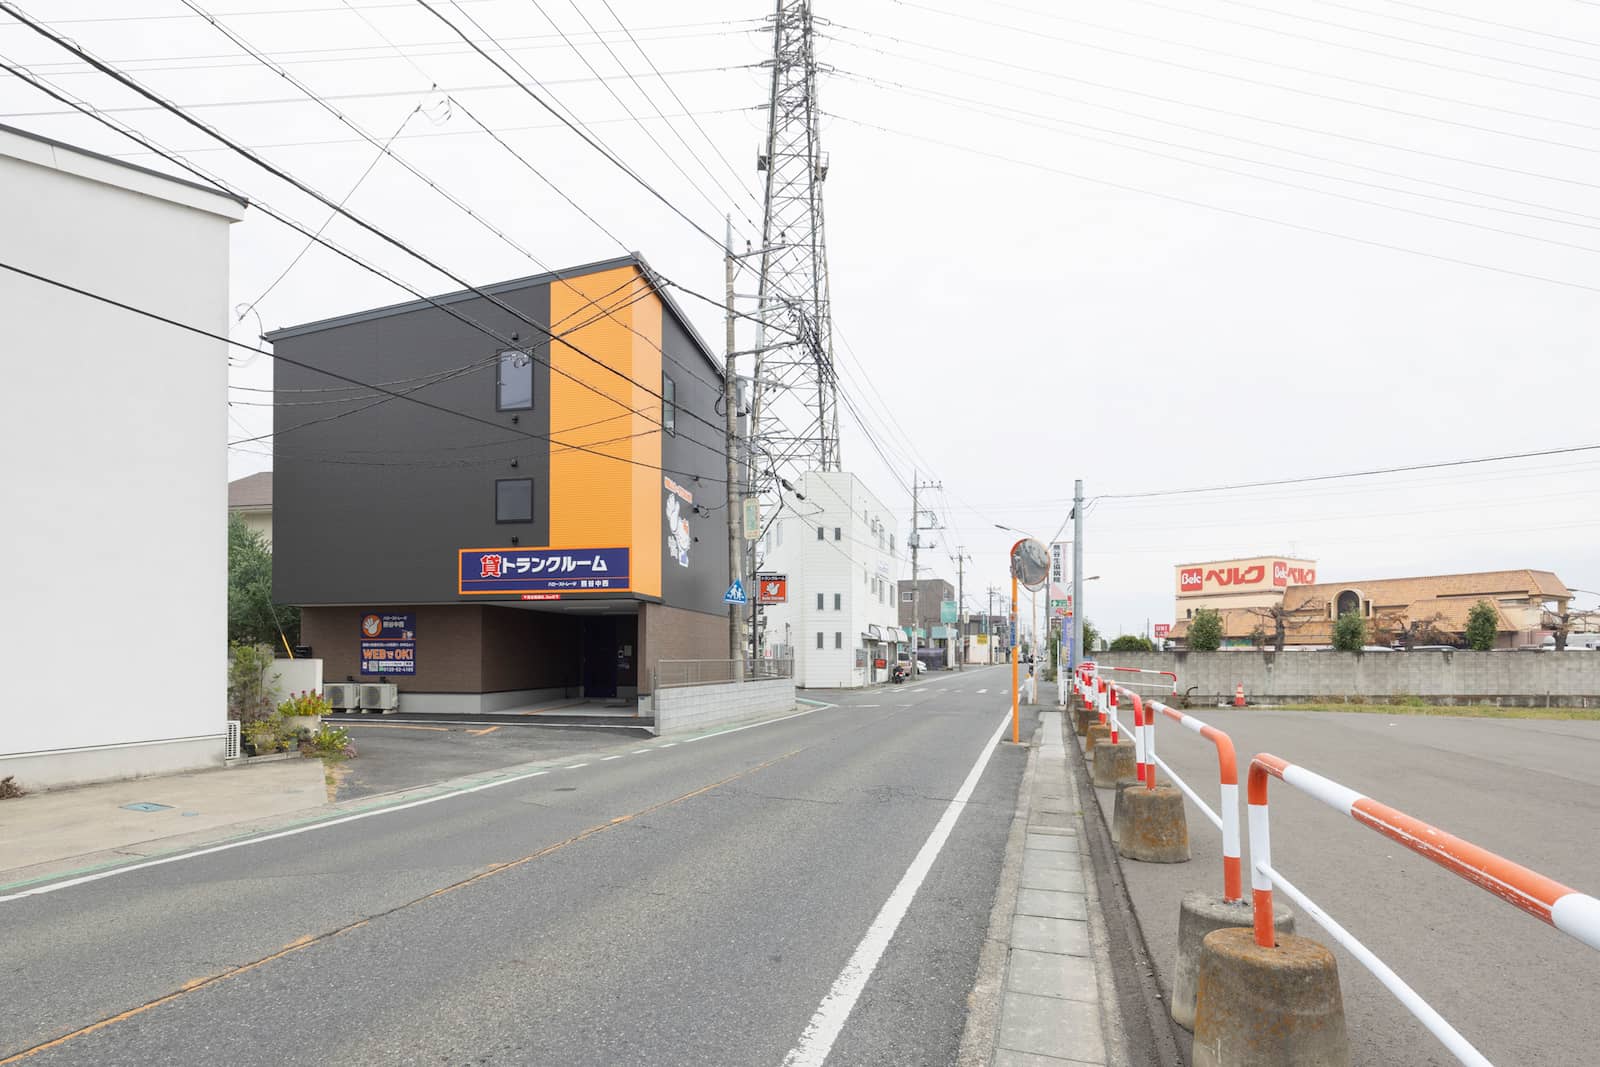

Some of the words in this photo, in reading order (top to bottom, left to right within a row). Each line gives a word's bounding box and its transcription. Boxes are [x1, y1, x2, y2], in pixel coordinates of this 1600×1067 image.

[480, 554, 608, 578] 貸トランクルーム
[1204, 565, 1265, 586] ベルク
